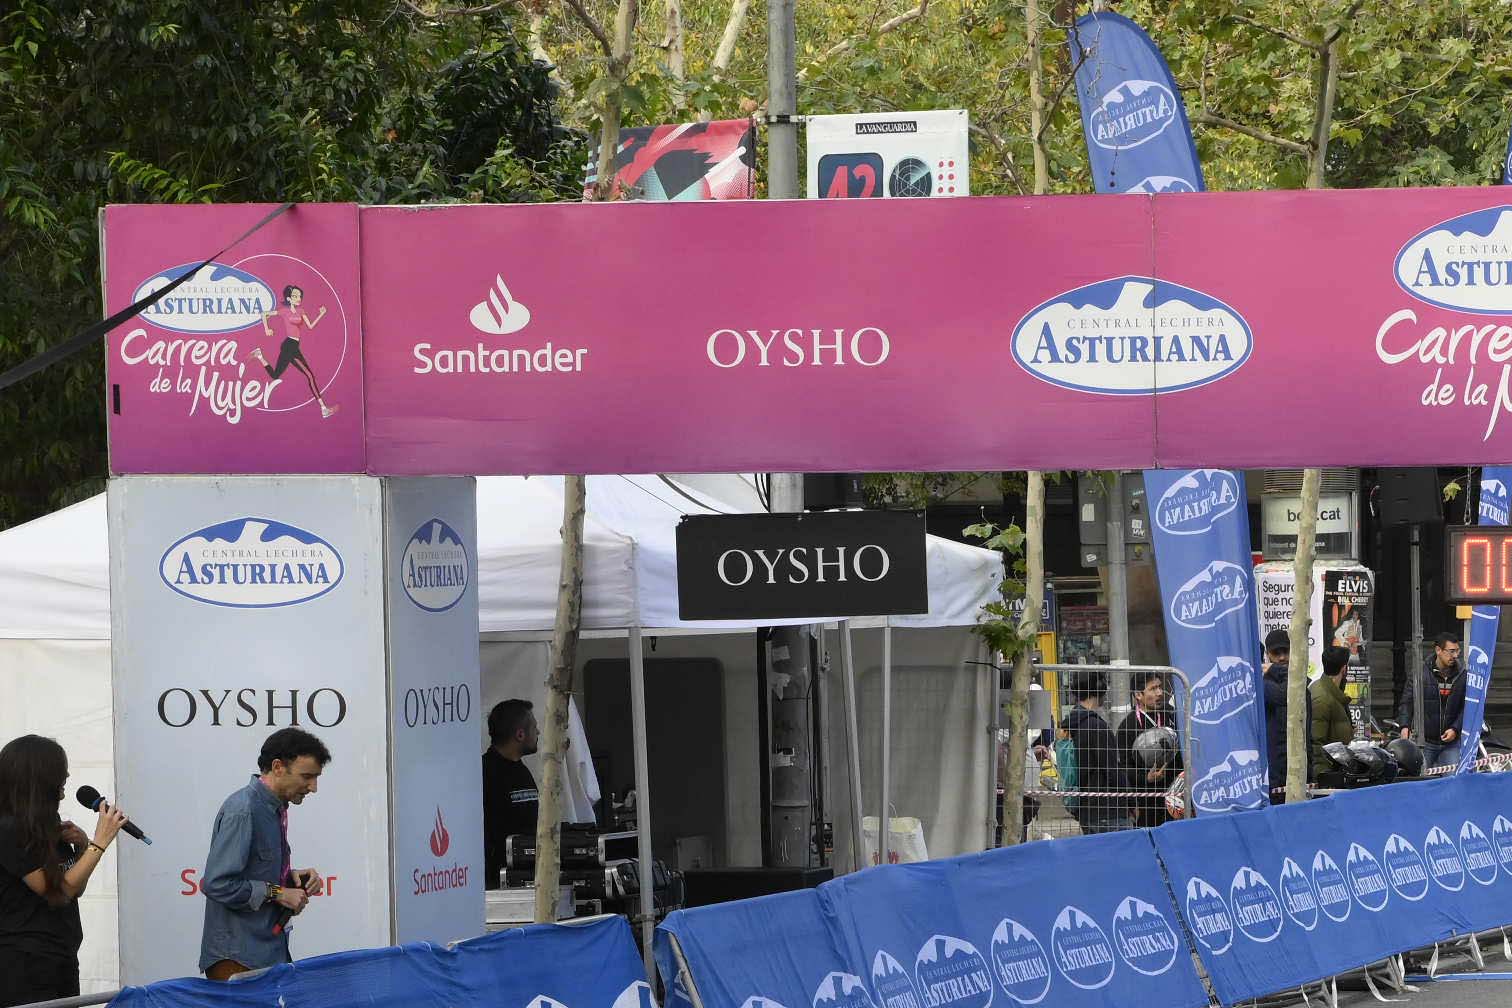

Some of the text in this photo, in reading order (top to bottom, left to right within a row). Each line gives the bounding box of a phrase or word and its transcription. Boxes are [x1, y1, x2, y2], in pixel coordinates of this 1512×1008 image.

[1067, 316, 1225, 330] CENTRAL LECHERA
[120, 328, 238, 366] Carrera
[413, 342, 588, 374] Santander
[706, 327, 890, 368] OYSHO
[1030, 321, 1234, 364] ASTURIANA
[150, 367, 192, 393] de la
[189, 360, 283, 424] Mujer
[1421, 367, 1489, 406] de la
[174, 551, 331, 585] ASTURIANA
[202, 548, 324, 558] CENTRAL LECHERA
[406, 553, 465, 590] ASTURIANA
[717, 544, 890, 586] OYSHO
[1338, 580, 1369, 592] ELVIS
[157, 687, 347, 728] OYSHO
[404, 683, 471, 729] OYSHO
[413, 862, 470, 897] Santander
